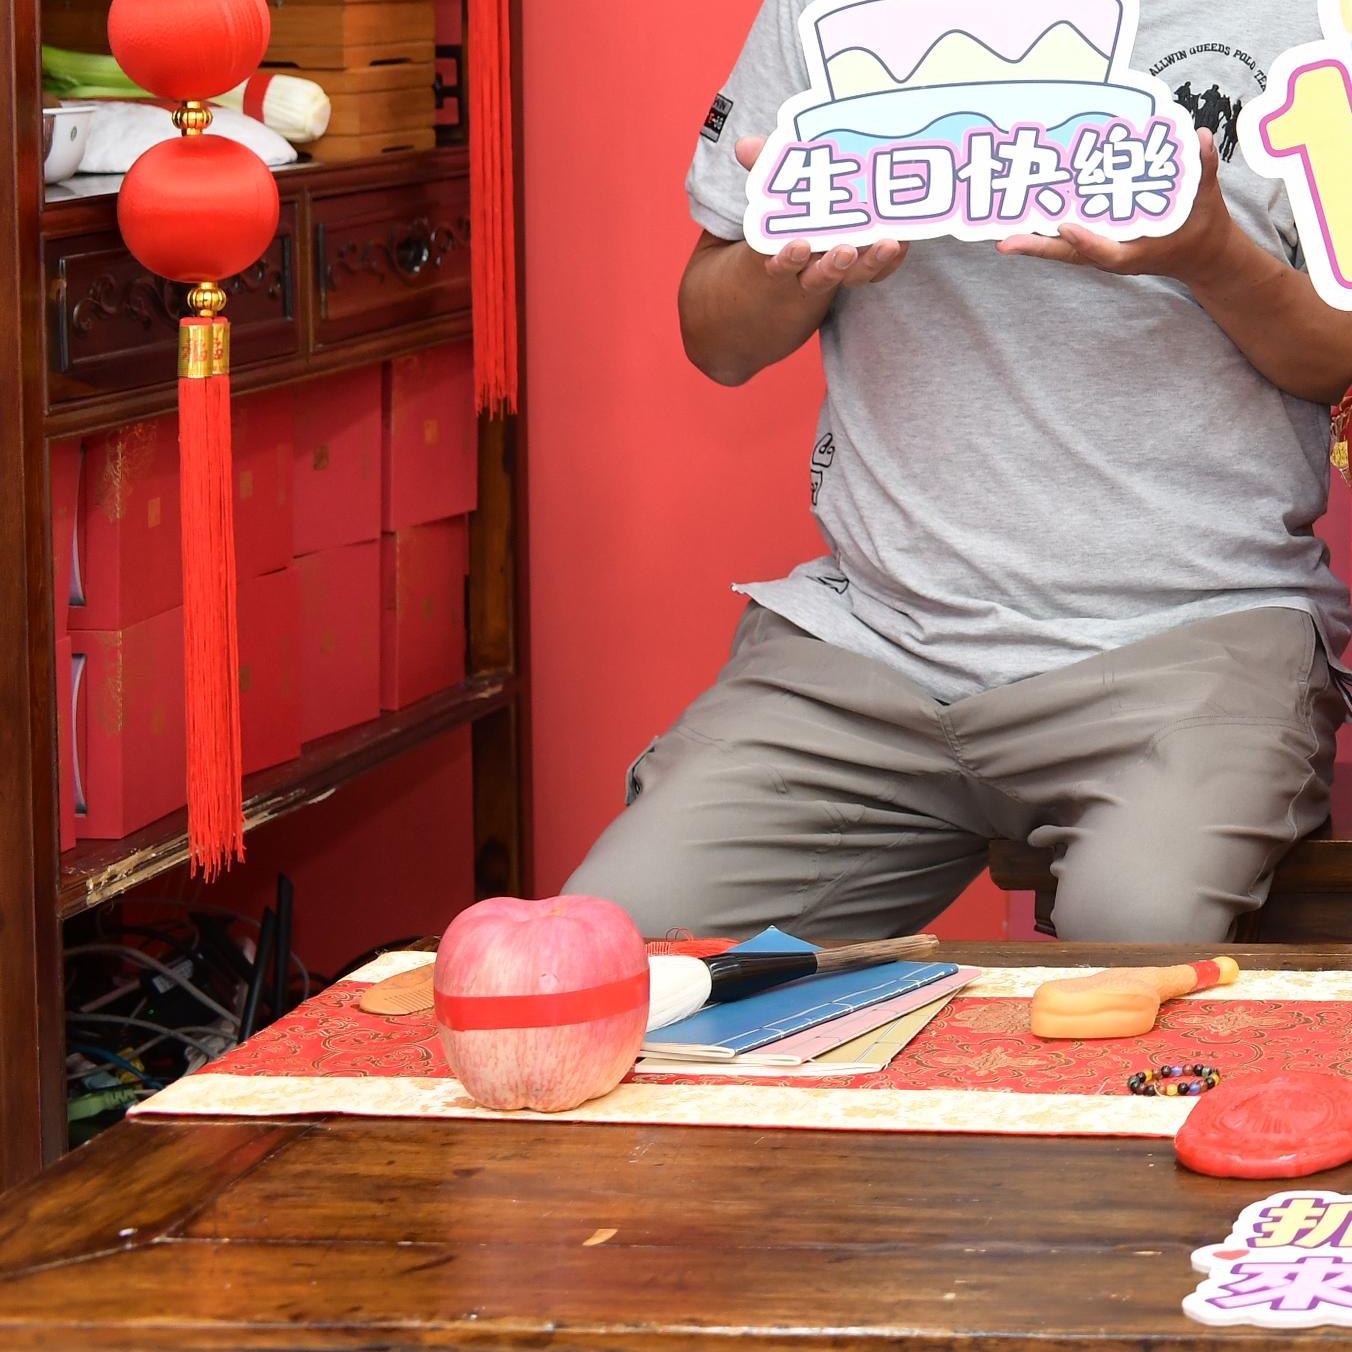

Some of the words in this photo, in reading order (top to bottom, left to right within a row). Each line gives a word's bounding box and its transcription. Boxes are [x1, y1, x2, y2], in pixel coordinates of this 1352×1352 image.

[1233, 49, 1256, 70] POLO
[764, 120, 1180, 235] 生日快樂
